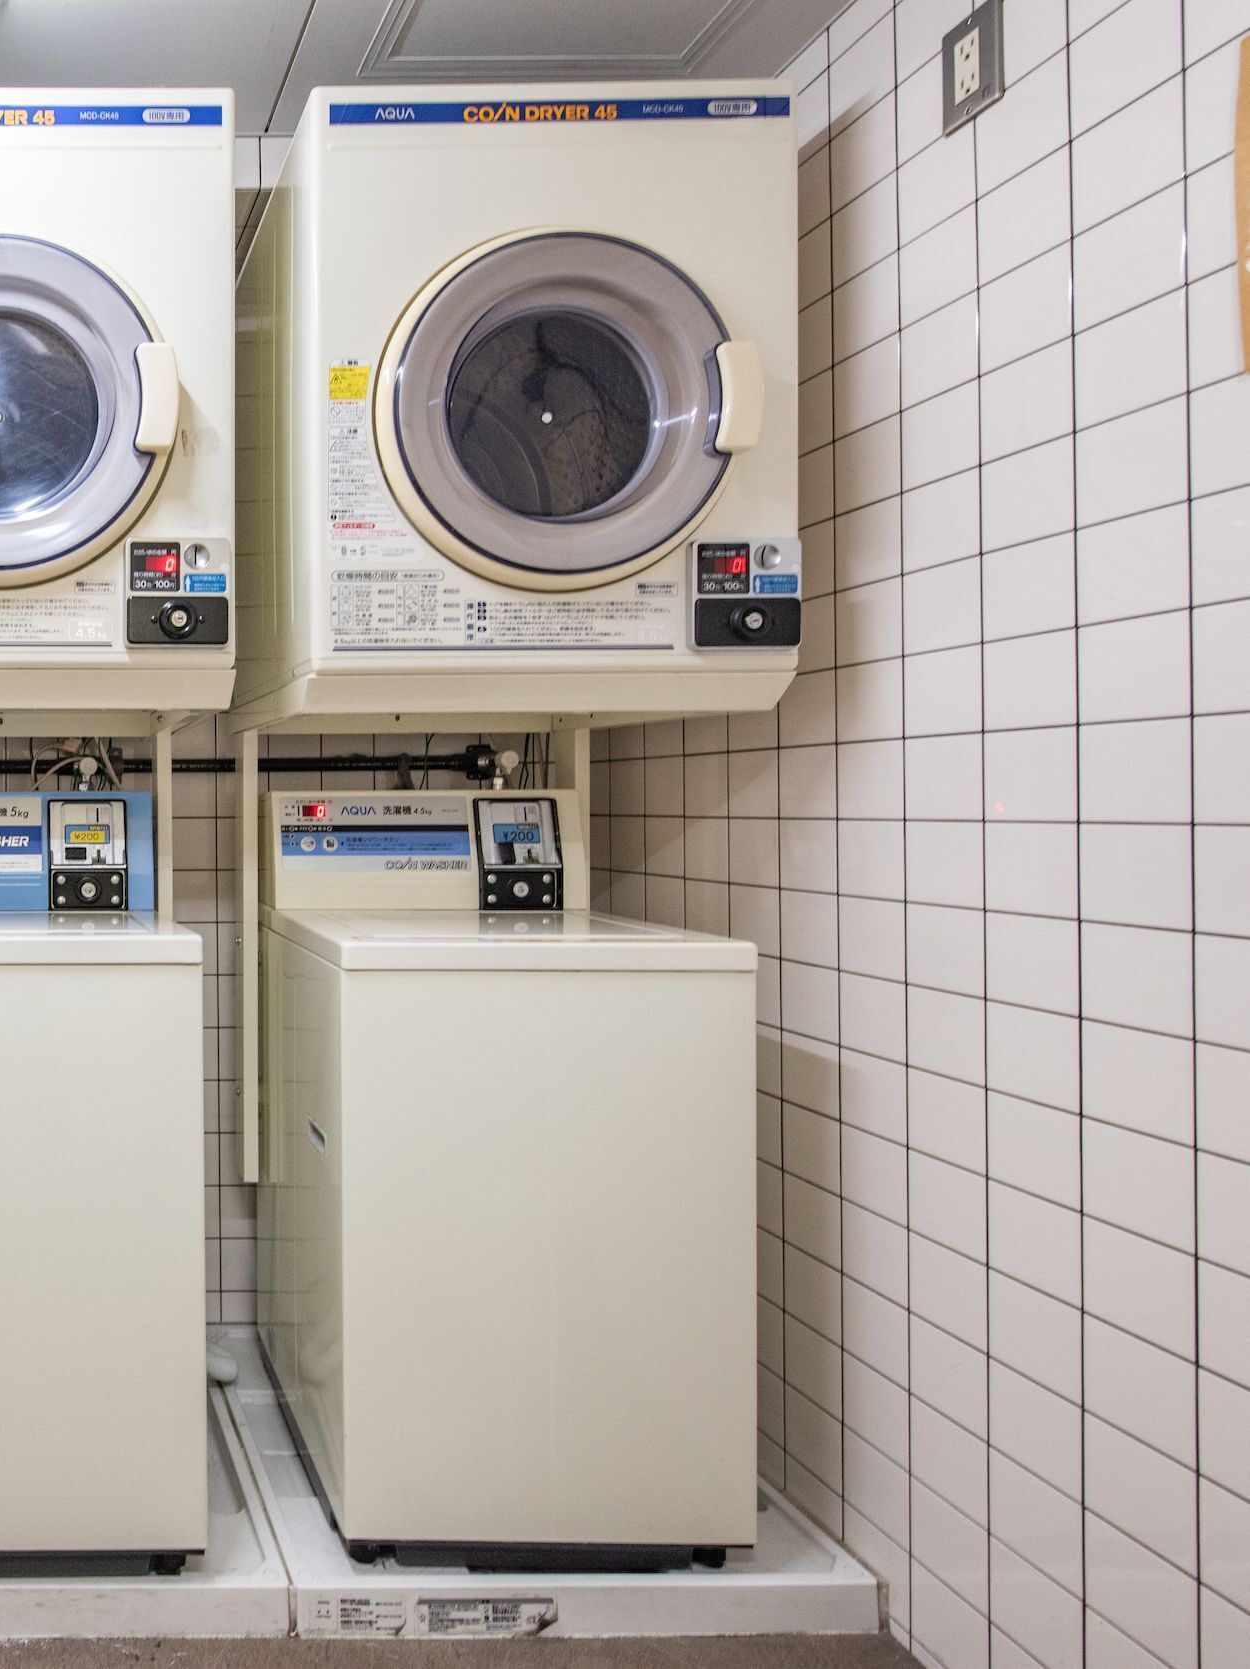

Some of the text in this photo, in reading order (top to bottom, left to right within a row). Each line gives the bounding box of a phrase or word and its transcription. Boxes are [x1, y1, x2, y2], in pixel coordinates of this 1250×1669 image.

[32, 110, 55, 126] 45
[374, 107, 415, 120] AQUA
[524, 104, 590, 121] DRYER
[594, 104, 618, 120] 45
[165, 557, 175, 572] 0
[732, 558, 742, 573] 0
[10, 806, 29, 819] 5kg
[316, 805, 325, 818] 0
[341, 806, 376, 816] AQUA
[382, 805, 412, 815] 洗濯機
[74, 832, 100, 841] ¥200
[420, 860, 468, 870] WASHER
